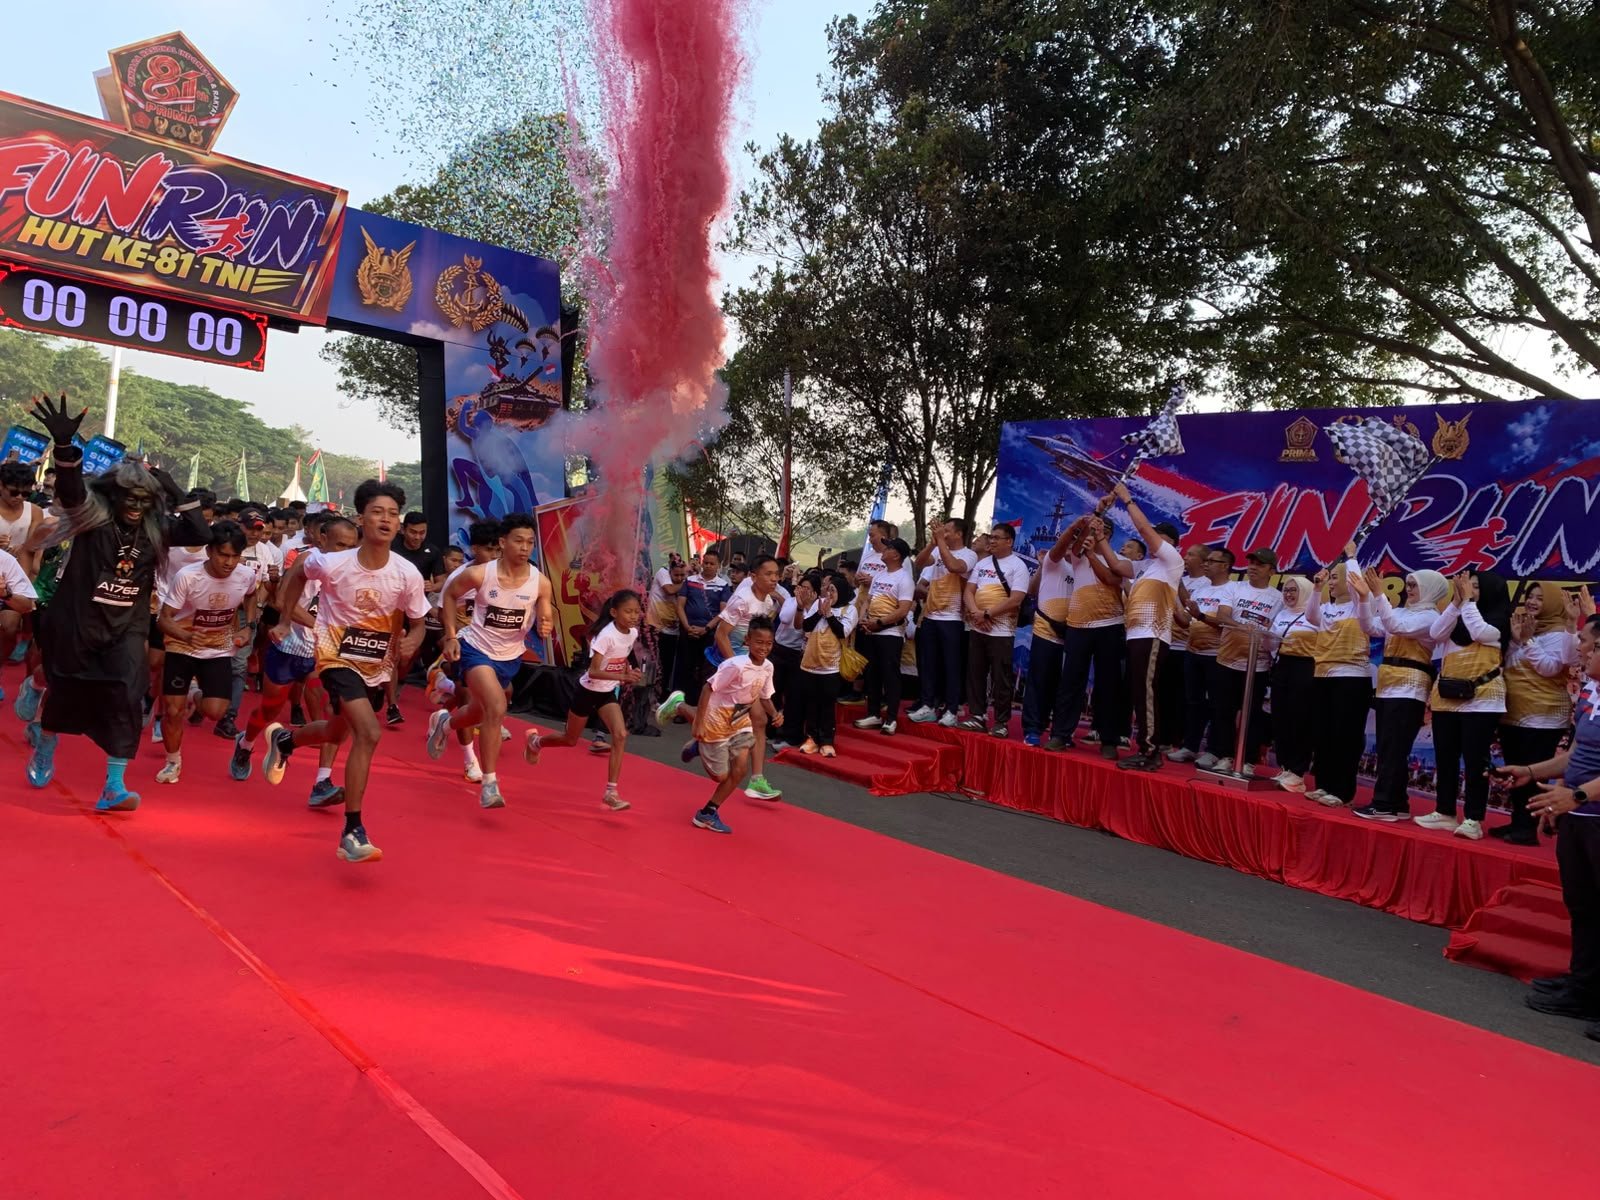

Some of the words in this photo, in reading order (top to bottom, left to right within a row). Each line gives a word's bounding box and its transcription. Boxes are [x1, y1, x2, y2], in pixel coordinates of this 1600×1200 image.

[142, 54, 204, 113] 81
[145, 101, 199, 126] PRIMA
[0, 142, 174, 233] FUN
[141, 168, 320, 270] RUN
[17, 215, 104, 256] HUT
[101, 235, 196, 279] KE-81
[199, 255, 257, 293] TNI
[22, 279, 87, 328] 00
[108, 296, 168, 342] 00
[188, 312, 243, 356] 00
[14, 432, 38, 447] PACE
[89, 451, 112, 467] SUB
[1281, 449, 1316, 458] PRIMA
[1178, 475, 1374, 573] FUN
[1355, 474, 1600, 577] RUN
[97, 581, 140, 596] A1762
[487, 612, 525, 623] A1320
[342, 635, 388, 650] A1502
